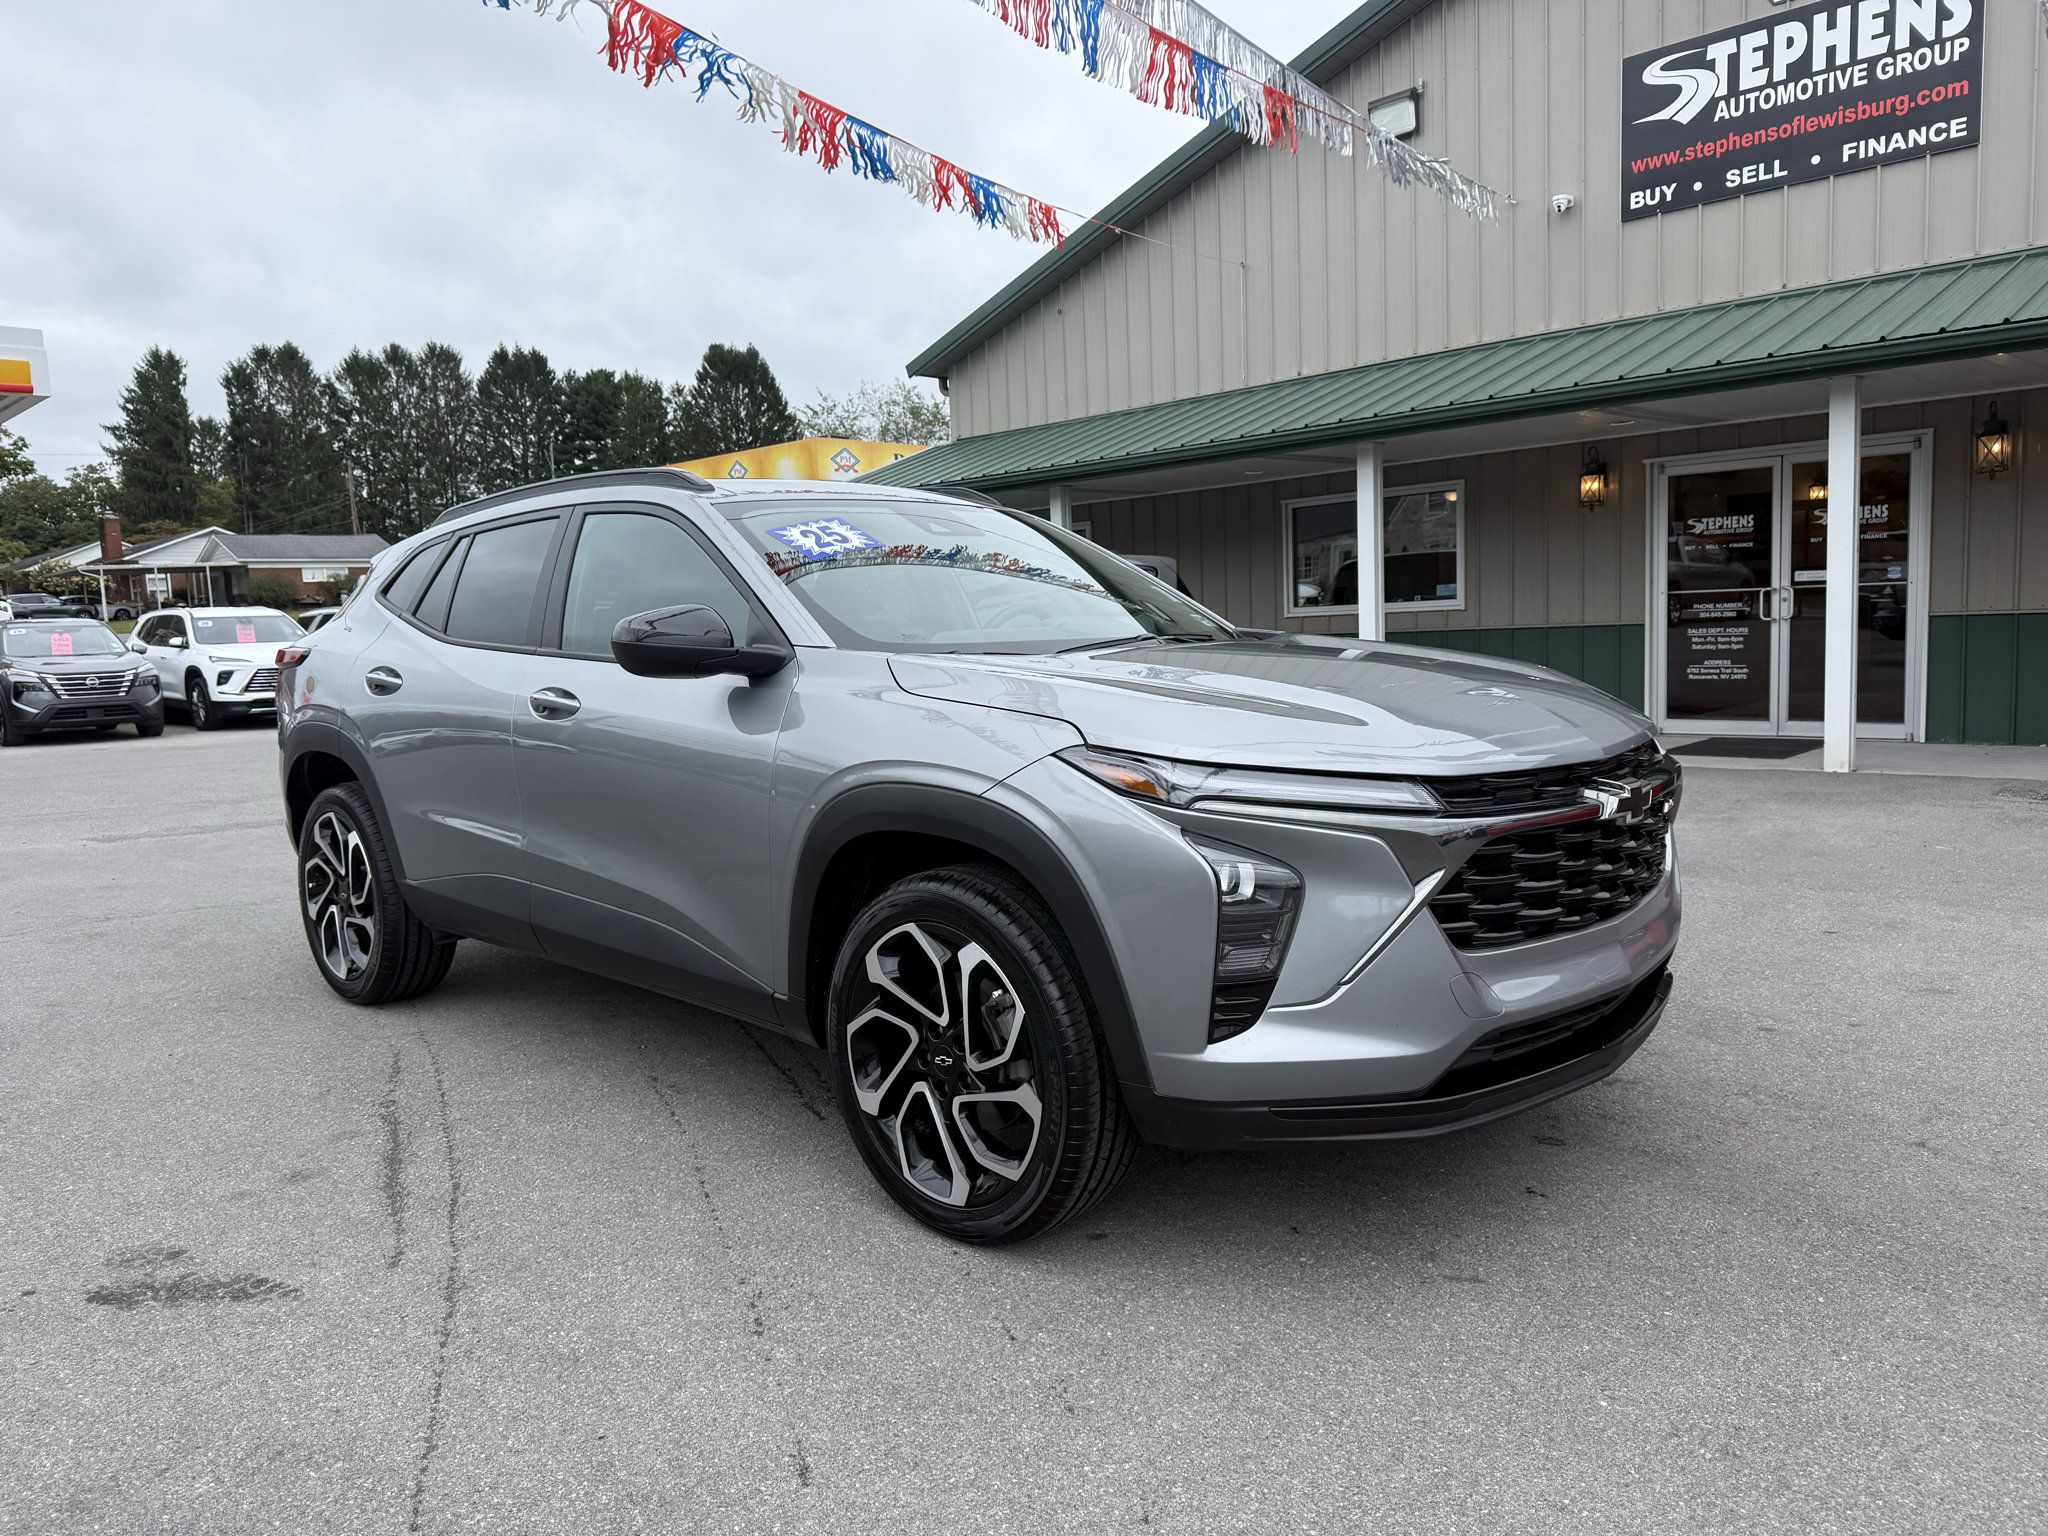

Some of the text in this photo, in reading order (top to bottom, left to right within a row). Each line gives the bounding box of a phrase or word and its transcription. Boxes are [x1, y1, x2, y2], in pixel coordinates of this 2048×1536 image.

[1632, 0, 1972, 125] STEPHENS
[1713, 36, 1971, 123] AUTOMOTIVE GROUP
[1630, 79, 1970, 174] www.stephensoflewisburg.com
[1629, 116, 1968, 211] BUY SELL FINANCE
[799, 525, 850, 549] 25
[1686, 514, 1755, 535] STEPHENS
[1703, 527, 1735, 535] AUTOMOTIVE
[1860, 532, 1888, 540] FINANCE
